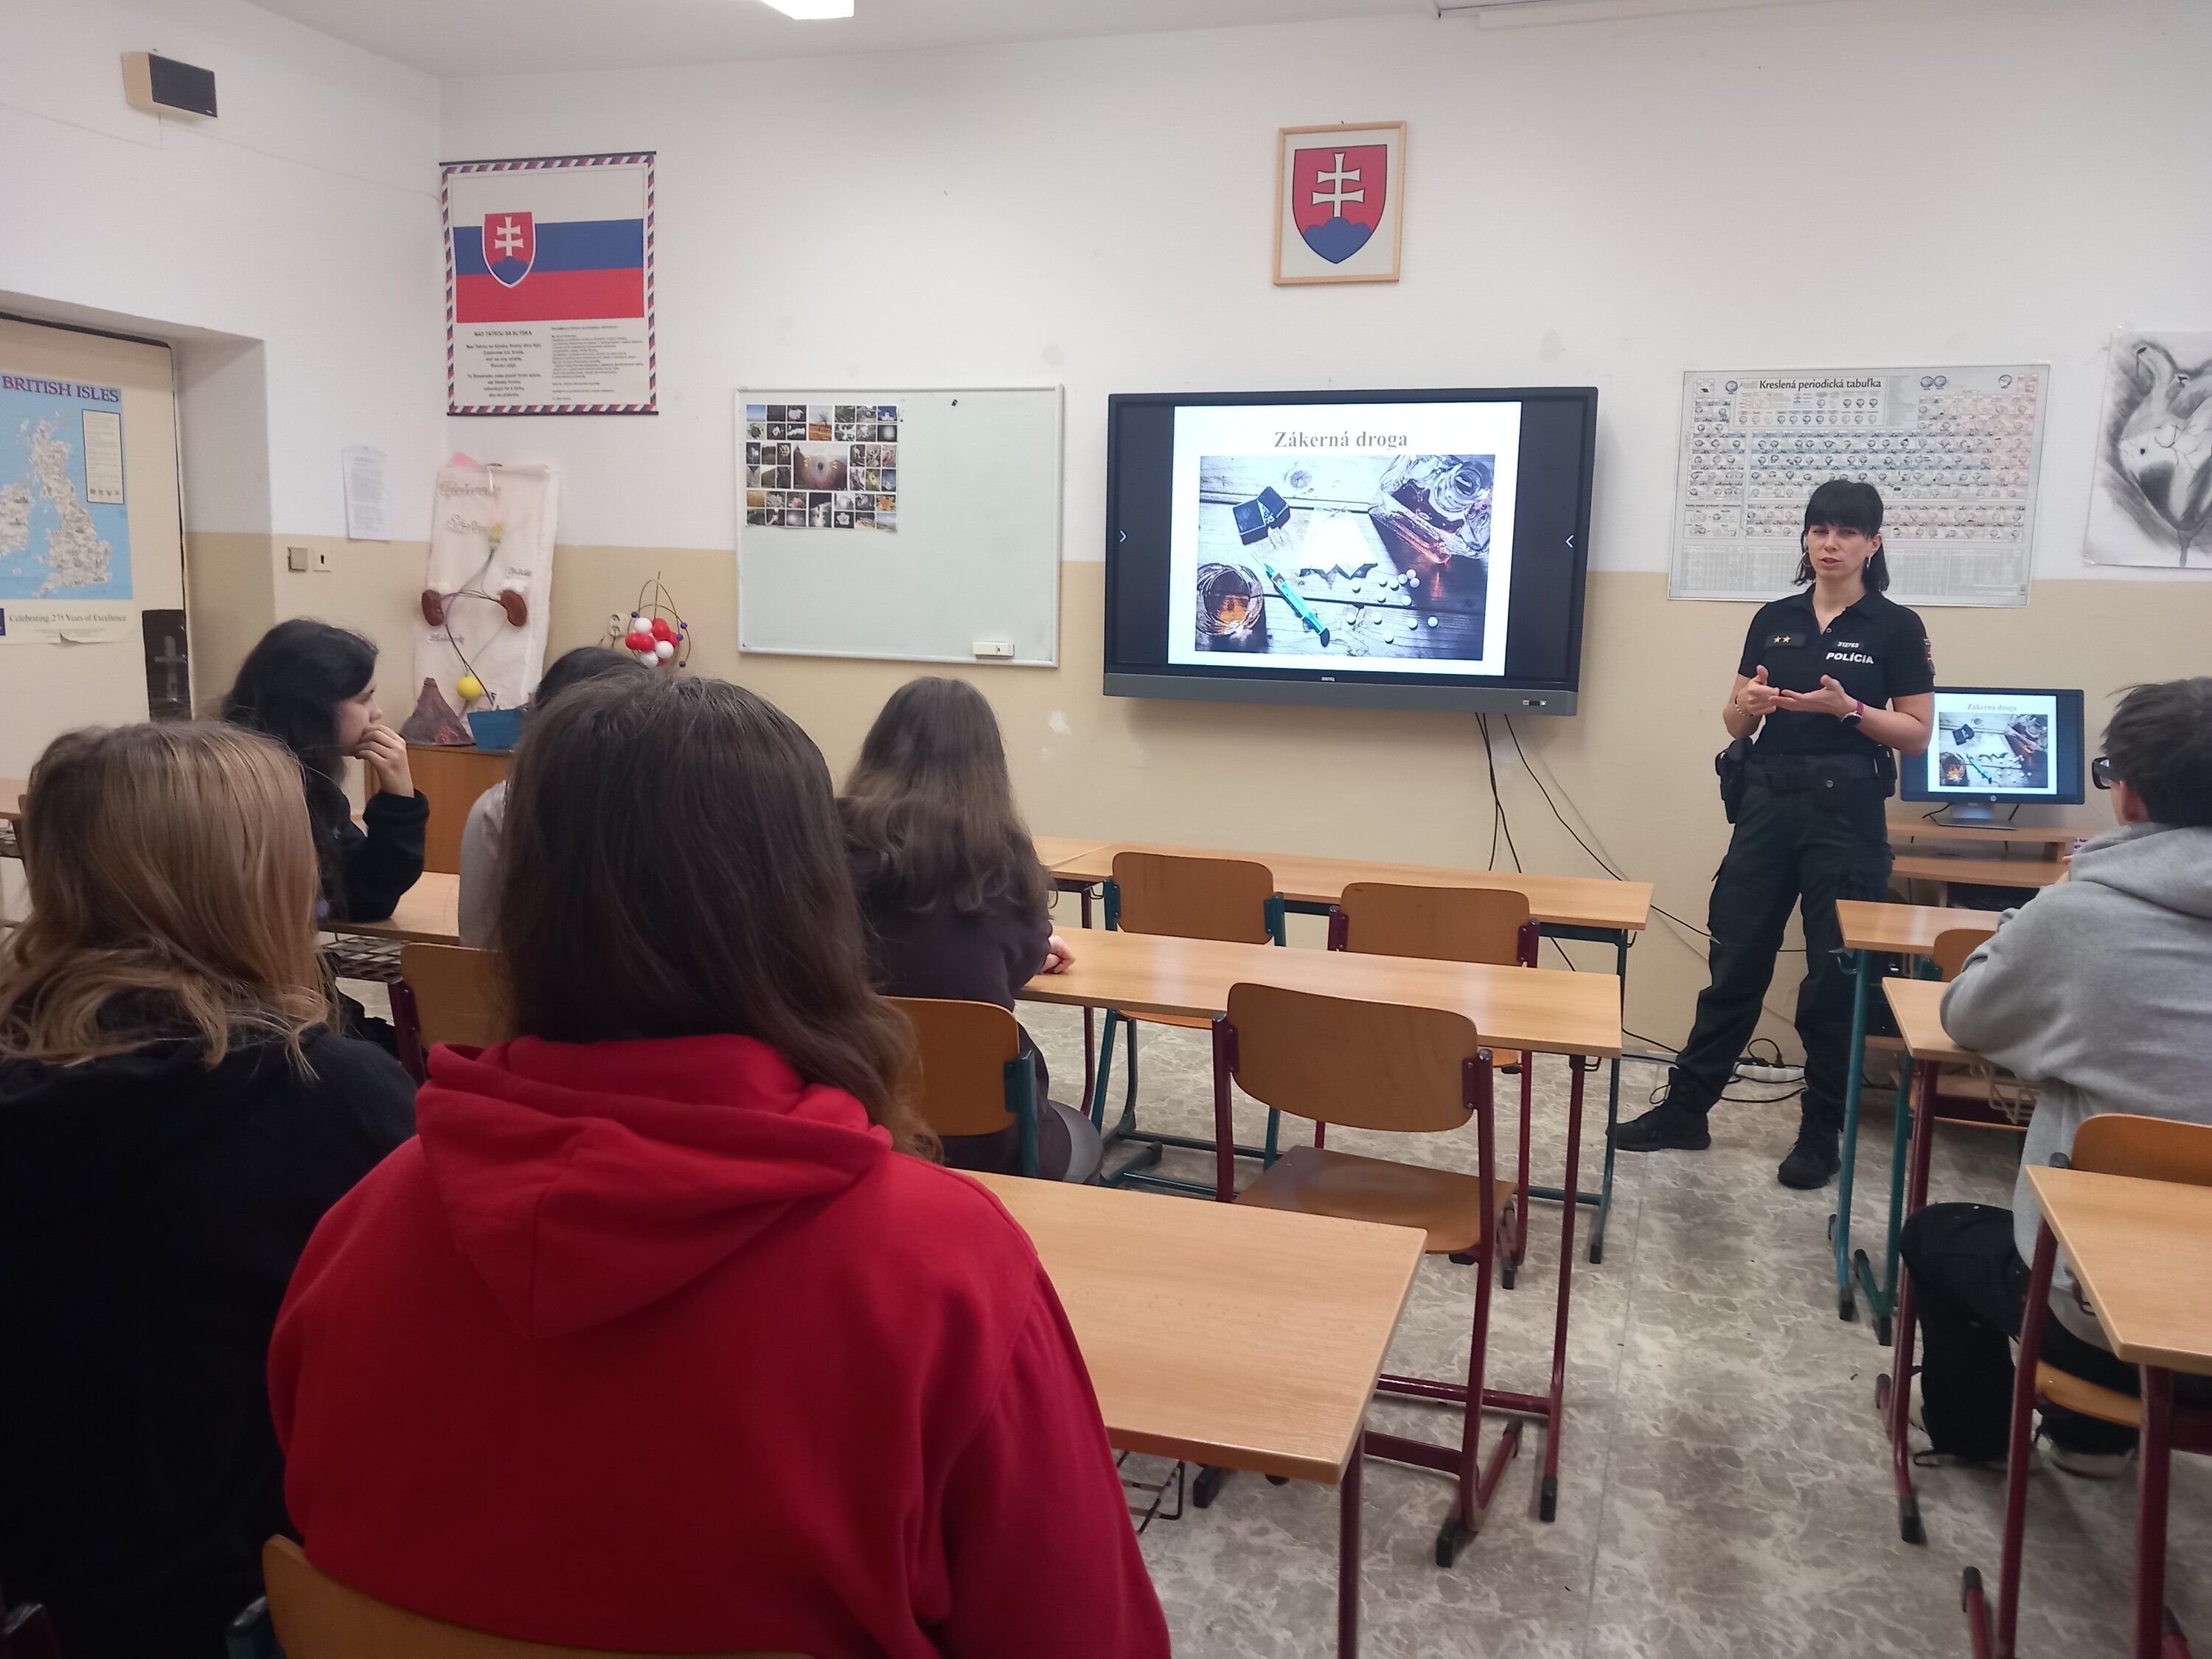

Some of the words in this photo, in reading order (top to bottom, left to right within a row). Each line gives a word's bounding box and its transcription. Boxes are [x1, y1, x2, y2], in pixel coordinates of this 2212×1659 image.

[1, 375, 72, 397] BRITISH
[76, 385, 119, 403] ISLES
[1759, 379, 1796, 389] Kreslená
[1798, 379, 1844, 392] periodická
[1846, 378, 1882, 388] tabuľka
[1274, 431, 1349, 448] Zákerná
[1356, 431, 1408, 451] droga
[9, 614, 50, 623] Celebrating
[52, 614, 64, 622] 275
[66, 614, 83, 622] Years
[85, 614, 91, 622] of
[93, 614, 127, 622] Excellence
[1826, 652, 1874, 664] POLÍCIA
[1966, 703, 1996, 711] Zákerná
[1997, 703, 2017, 712] droga
